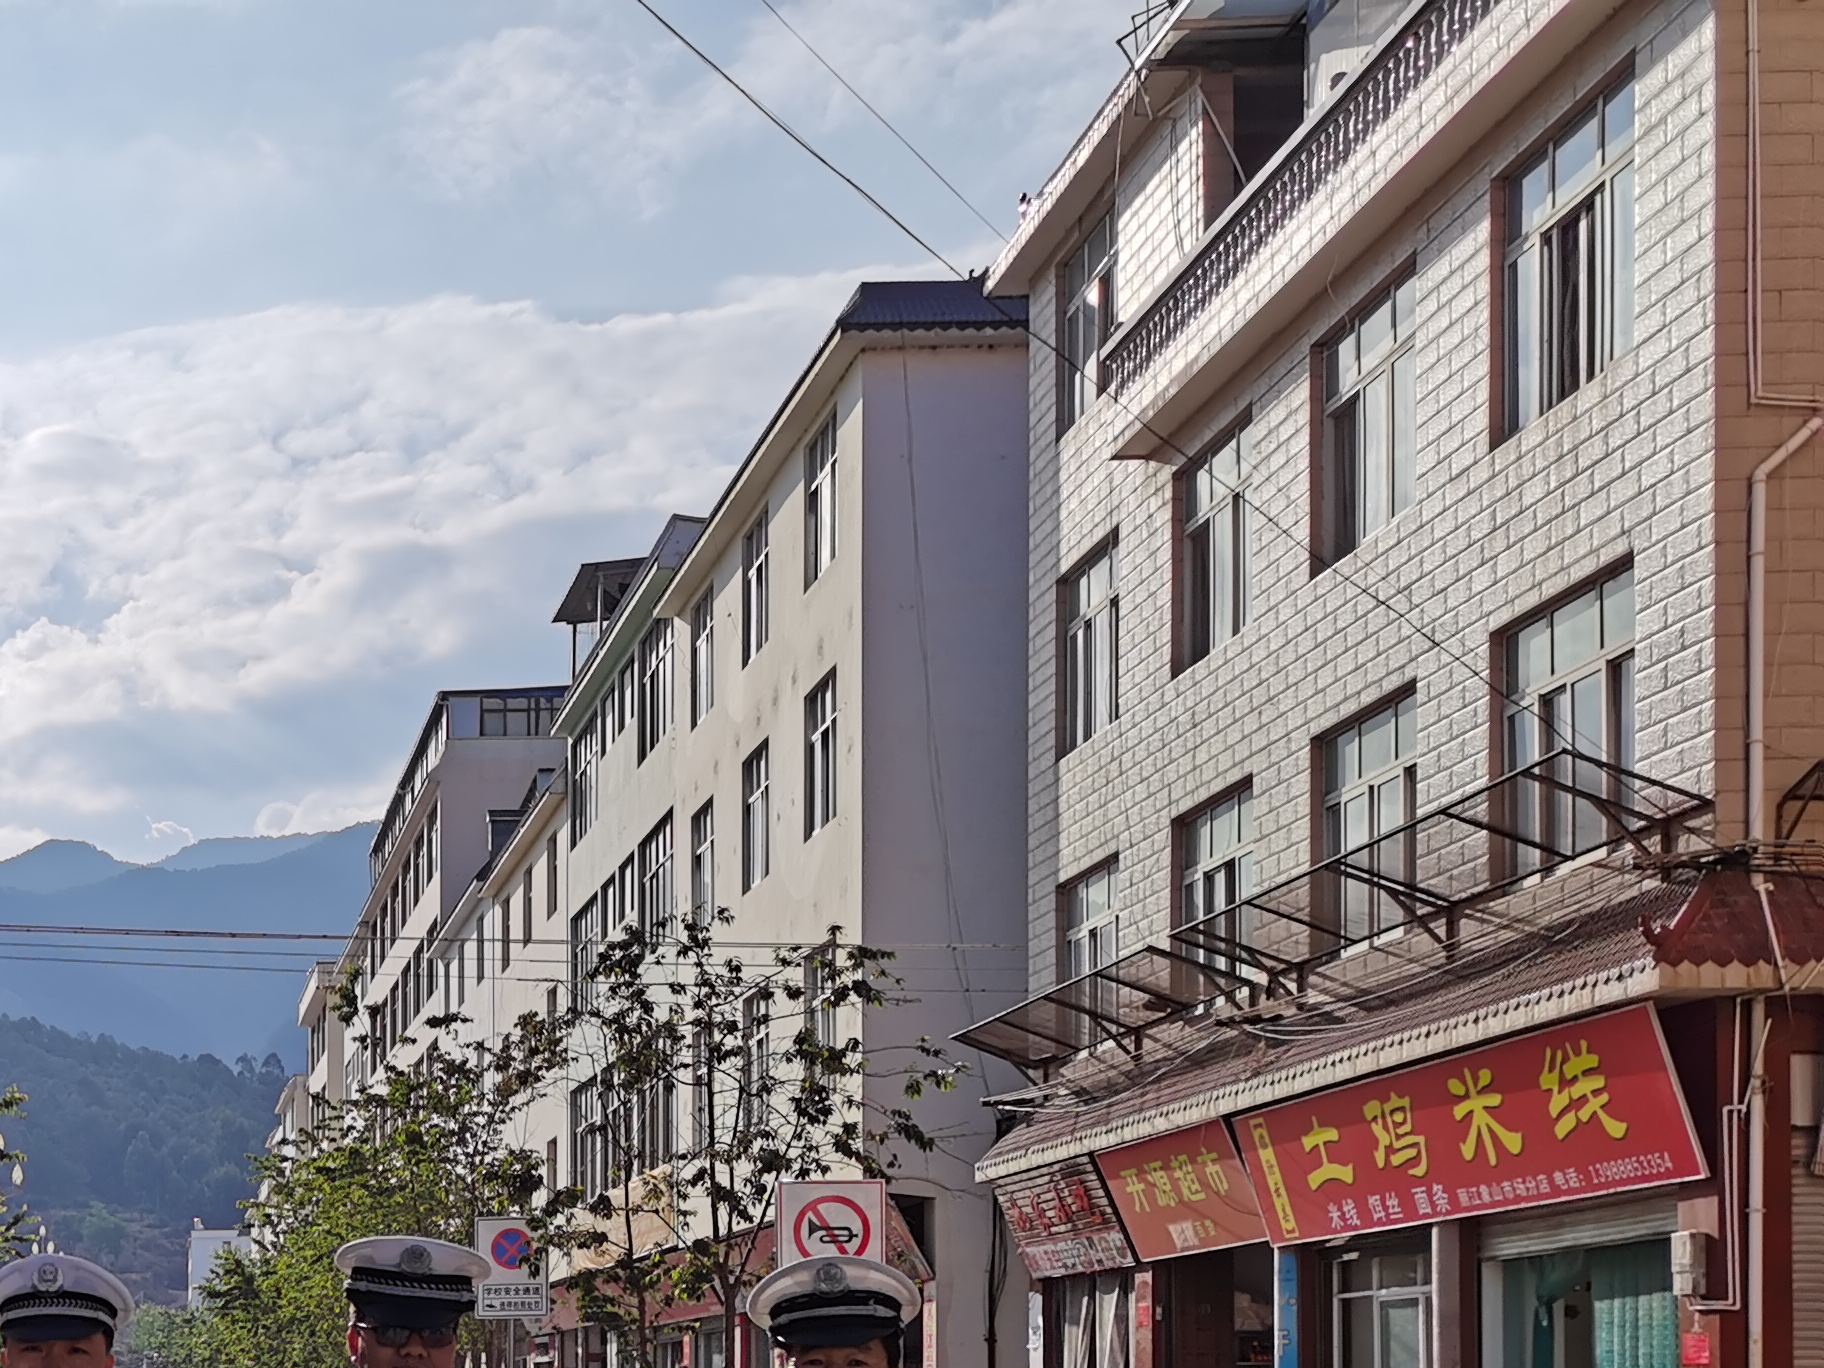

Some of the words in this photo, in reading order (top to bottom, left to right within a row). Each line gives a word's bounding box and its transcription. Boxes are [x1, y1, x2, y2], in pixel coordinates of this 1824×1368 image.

[1301, 1038, 1628, 1192] 土鸡米线
[1119, 1146, 1230, 1213] 开源超市
[1328, 1199, 1362, 1230] 米线
[1367, 1191, 1405, 1222] 饵丝
[1411, 1182, 1452, 1214] 面条
[484, 1286, 541, 1297] 学校安全通道
